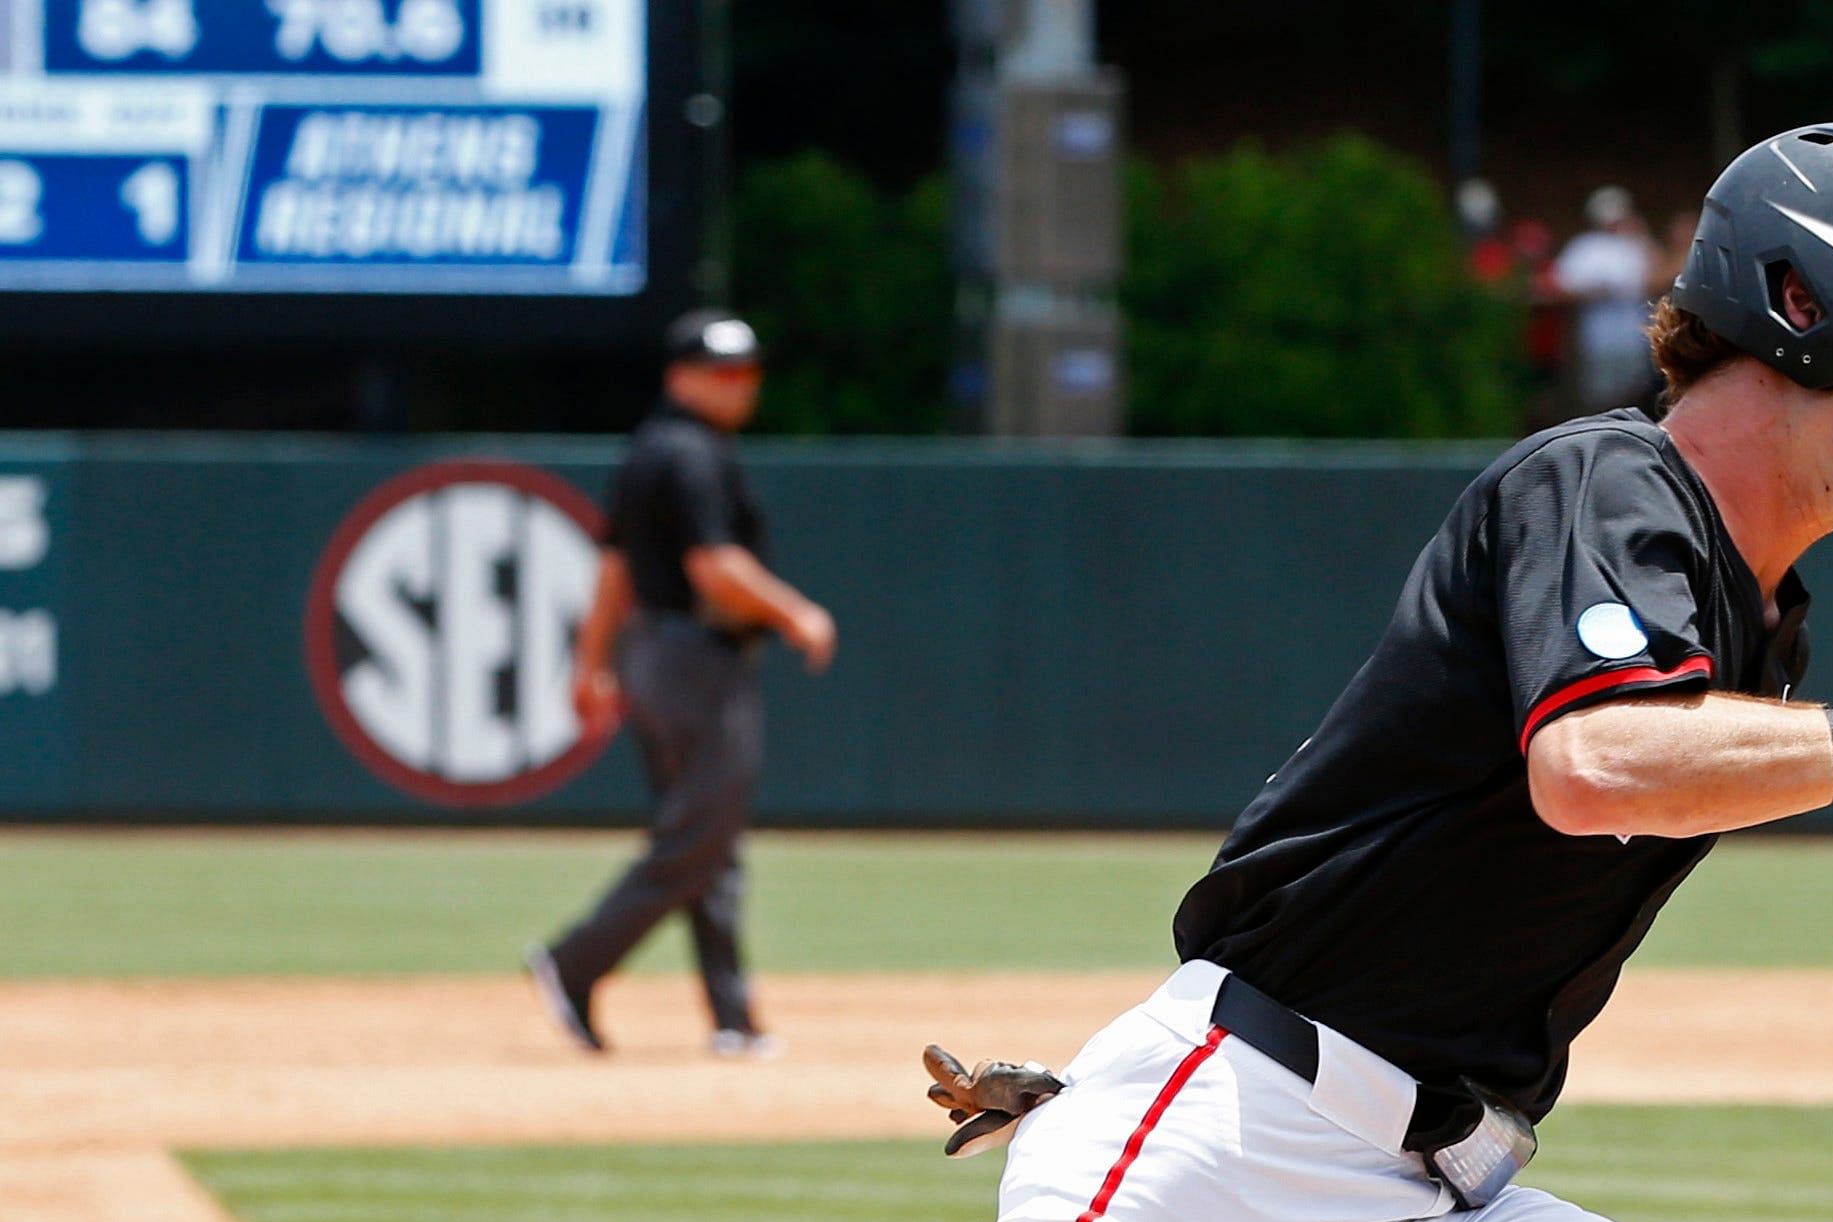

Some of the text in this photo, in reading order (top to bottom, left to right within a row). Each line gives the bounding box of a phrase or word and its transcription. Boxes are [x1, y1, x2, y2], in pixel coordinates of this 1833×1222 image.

[288, 112, 541, 178] ATHENS
[120, 161, 179, 245] 1
[258, 182, 562, 257] REGIONAL
